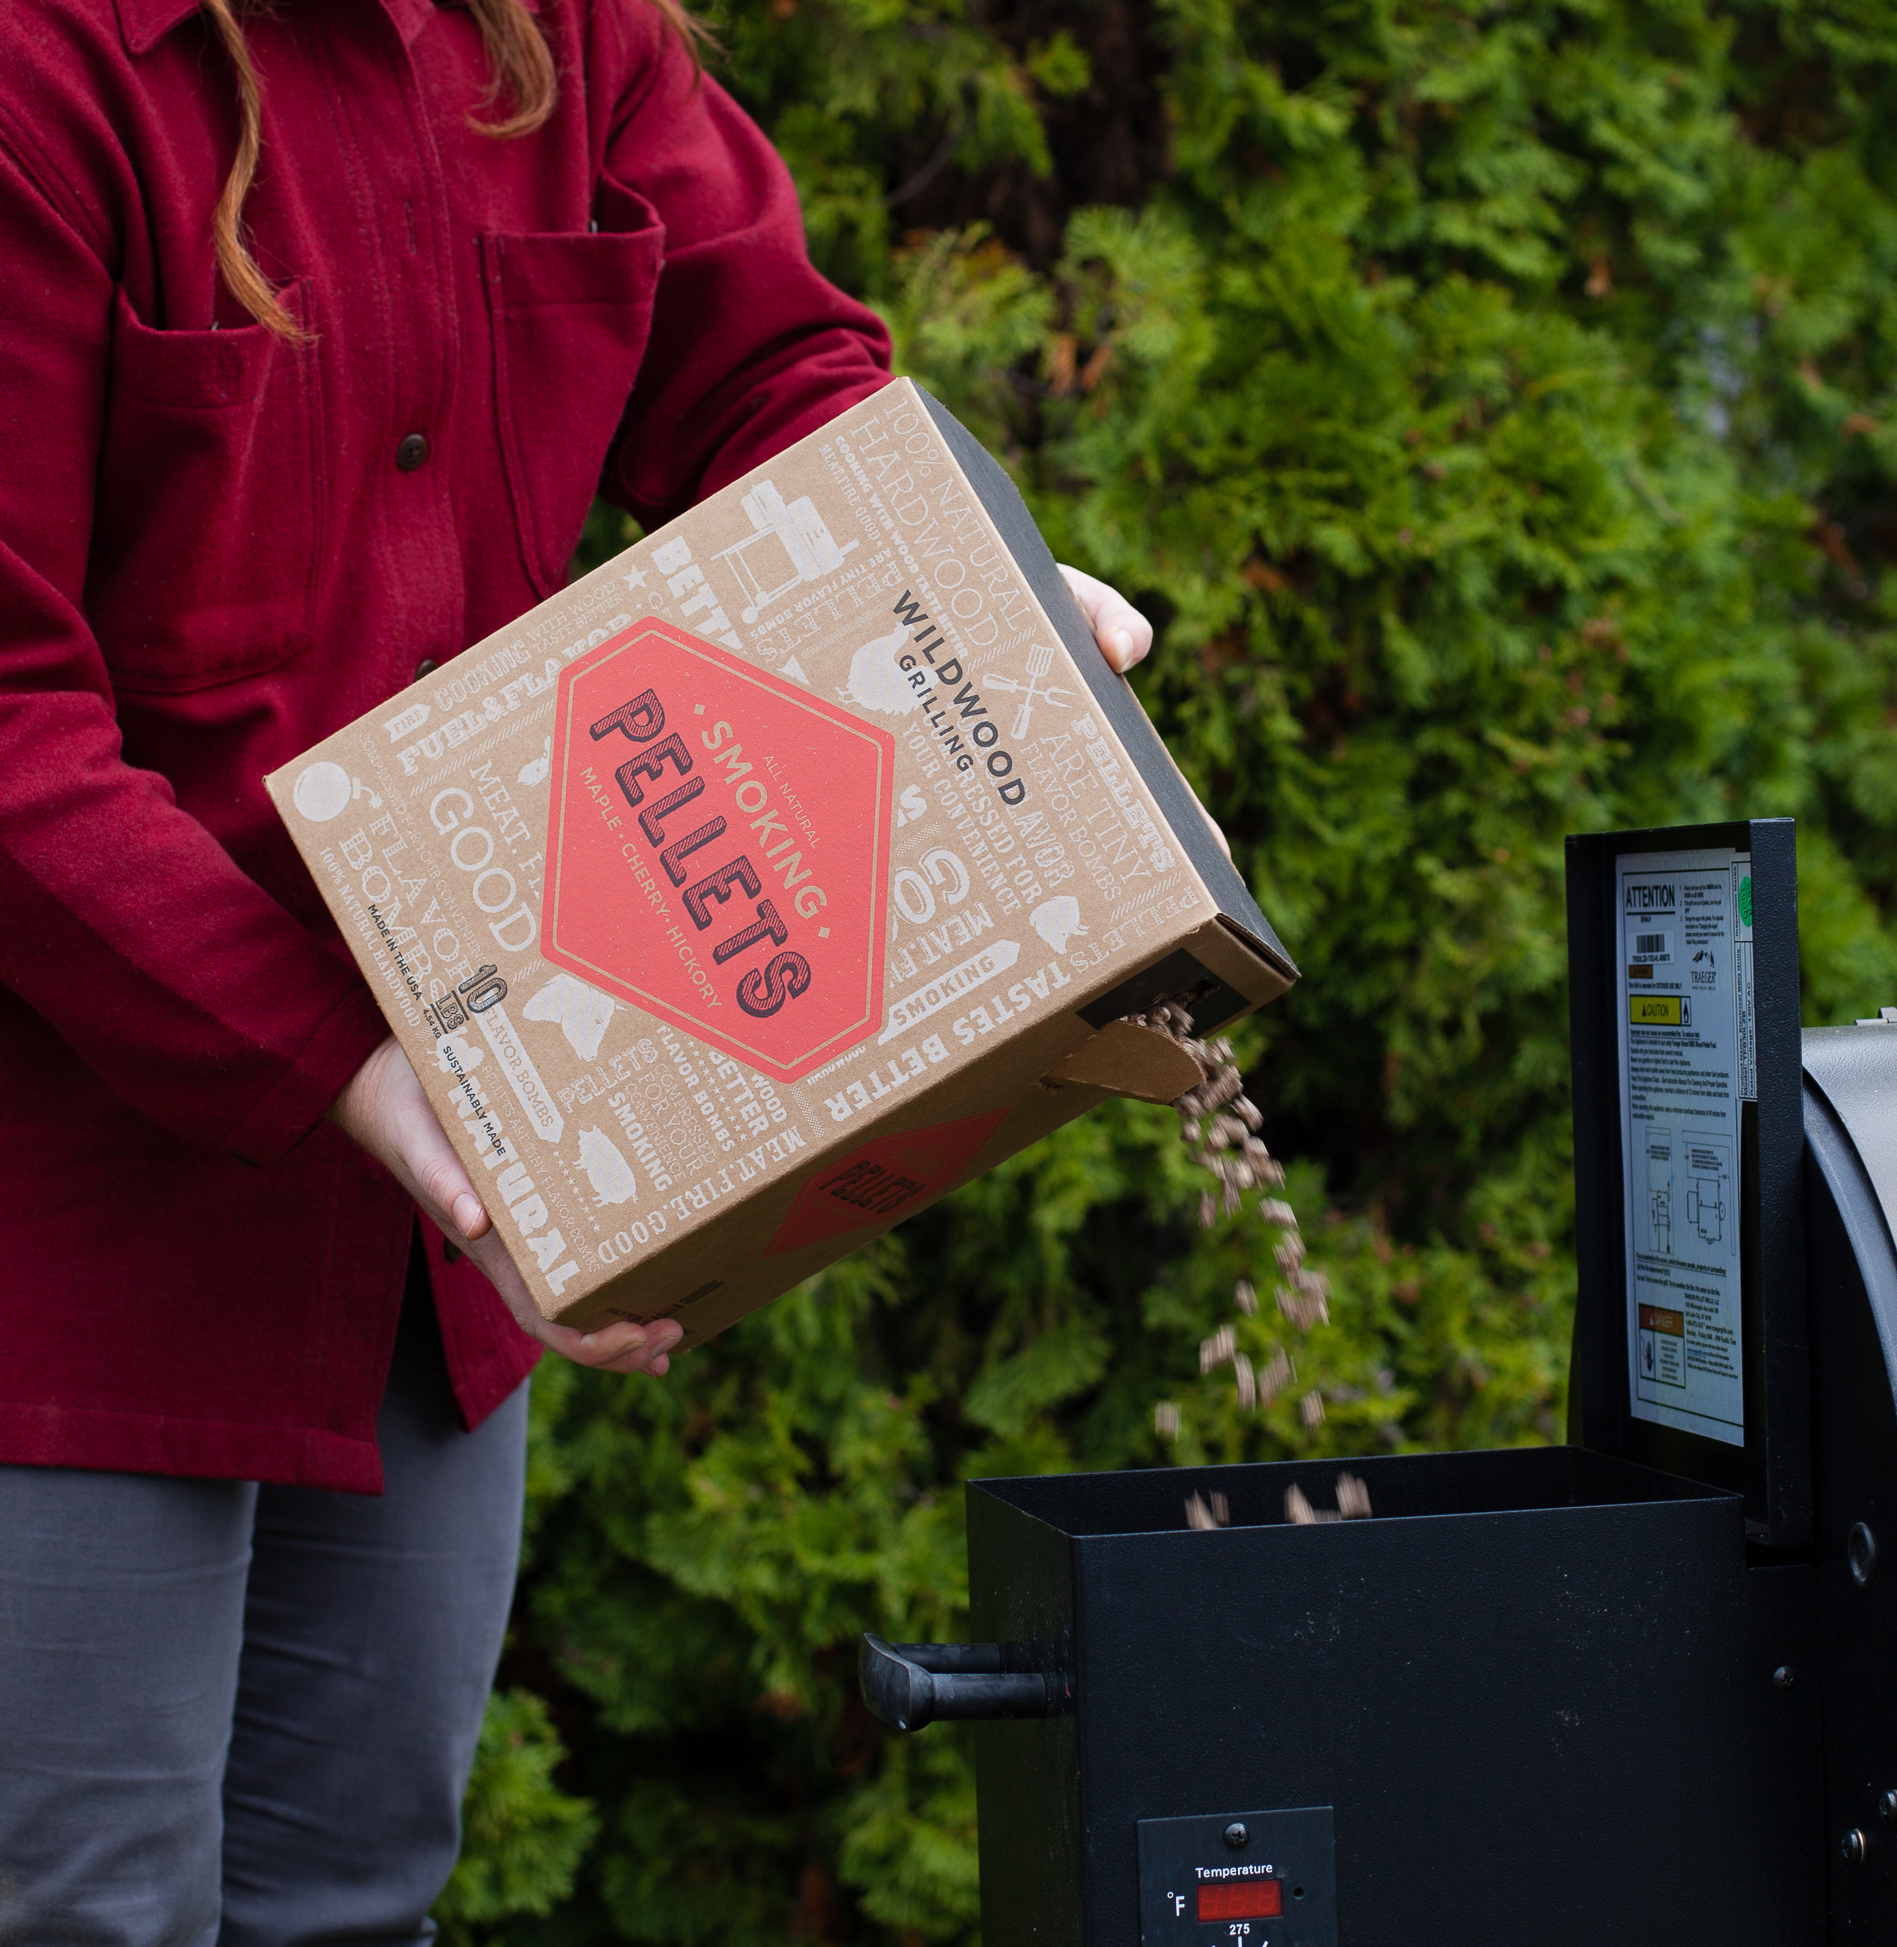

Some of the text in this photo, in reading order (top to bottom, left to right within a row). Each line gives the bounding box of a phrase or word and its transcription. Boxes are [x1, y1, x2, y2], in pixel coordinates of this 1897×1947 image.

[832, 434, 969, 660] COOKING WITH WOOD TASTE BETTER
[848, 414, 1003, 652] HARDWOOD
[882, 396, 1035, 632] 100% NATURAL
[525, 610, 568, 643] WITH
[566, 579, 617, 617] WOOD
[531, 622, 575, 655] TASTE
[572, 592, 623, 629] BETTER
[749, 546, 893, 641] ARE TINY FLAVOR BOMBS
[754, 558, 905, 666] PELLETS
[393, 709, 423, 734] FIRE
[432, 637, 532, 714] COOKING
[887, 585, 1035, 810] WILDWOOD
[896, 652, 975, 773] GRILLING
[356, 731, 409, 816] COMPRESSED
[400, 814, 423, 843] FOR
[415, 841, 442, 880] YOUR
[467, 758, 534, 855] MEAT.
[697, 716, 830, 922] SMOKING
[761, 752, 822, 849] ALL NATURAL
[899, 721, 943, 780] YOUR
[931, 776, 1022, 917] CONVENIENCE
[1018, 740, 1123, 903] FLAVOR BOMBS
[1038, 723, 1152, 890] ARE TINY
[1068, 711, 1177, 875] PELLETS
[421, 779, 545, 960] GOOD
[579, 766, 722, 1012] MAPLE CHERRY HICKORY
[586, 686, 820, 1027] PELLETS
[1003, 853, 1045, 905] FOR
[1626, 885, 1675, 907] ATTENTION
[317, 845, 422, 1028] 100% NATURAL HARDWOOD
[366, 904, 423, 1001] MADE IN THE USA
[1067, 883, 1200, 975] PELLETS
[421, 1007, 442, 1039] 4.54 KG
[434, 992, 466, 1032] LBS
[455, 959, 512, 1017] 10
[891, 953, 997, 1027] SMOKING
[1647, 1004, 1669, 1017] CAUTION
[481, 1005, 555, 1129] FLAVOR BOMBS
[555, 1036, 660, 1115] PELLETS
[656, 1022, 736, 1153] FLAVOR BOMBS
[707, 1043, 771, 1137] BETTER
[823, 957, 1073, 1124] TASTES BETTER
[441, 1045, 506, 1157] SUSTAINABLY MADE
[480, 1063, 516, 1118] PELLETS
[507, 1114, 532, 1148] ARE
[522, 1142, 548, 1177] TINY
[539, 1174, 575, 1228] FLAVOR
[606, 1089, 673, 1193] SMOKING
[623, 1081, 686, 1184] CONVENIENCE
[636, 1070, 704, 1176] FOR YOUR
[653, 1061, 717, 1166] COMPRESSED
[749, 1069, 788, 1124] WOOD
[446, 1075, 584, 1298] NATURAL
[812, 1159, 932, 1215] PELLETS
[1195, 1863, 1273, 1879] Temperature
[1229, 1923, 1250, 1936] 275
